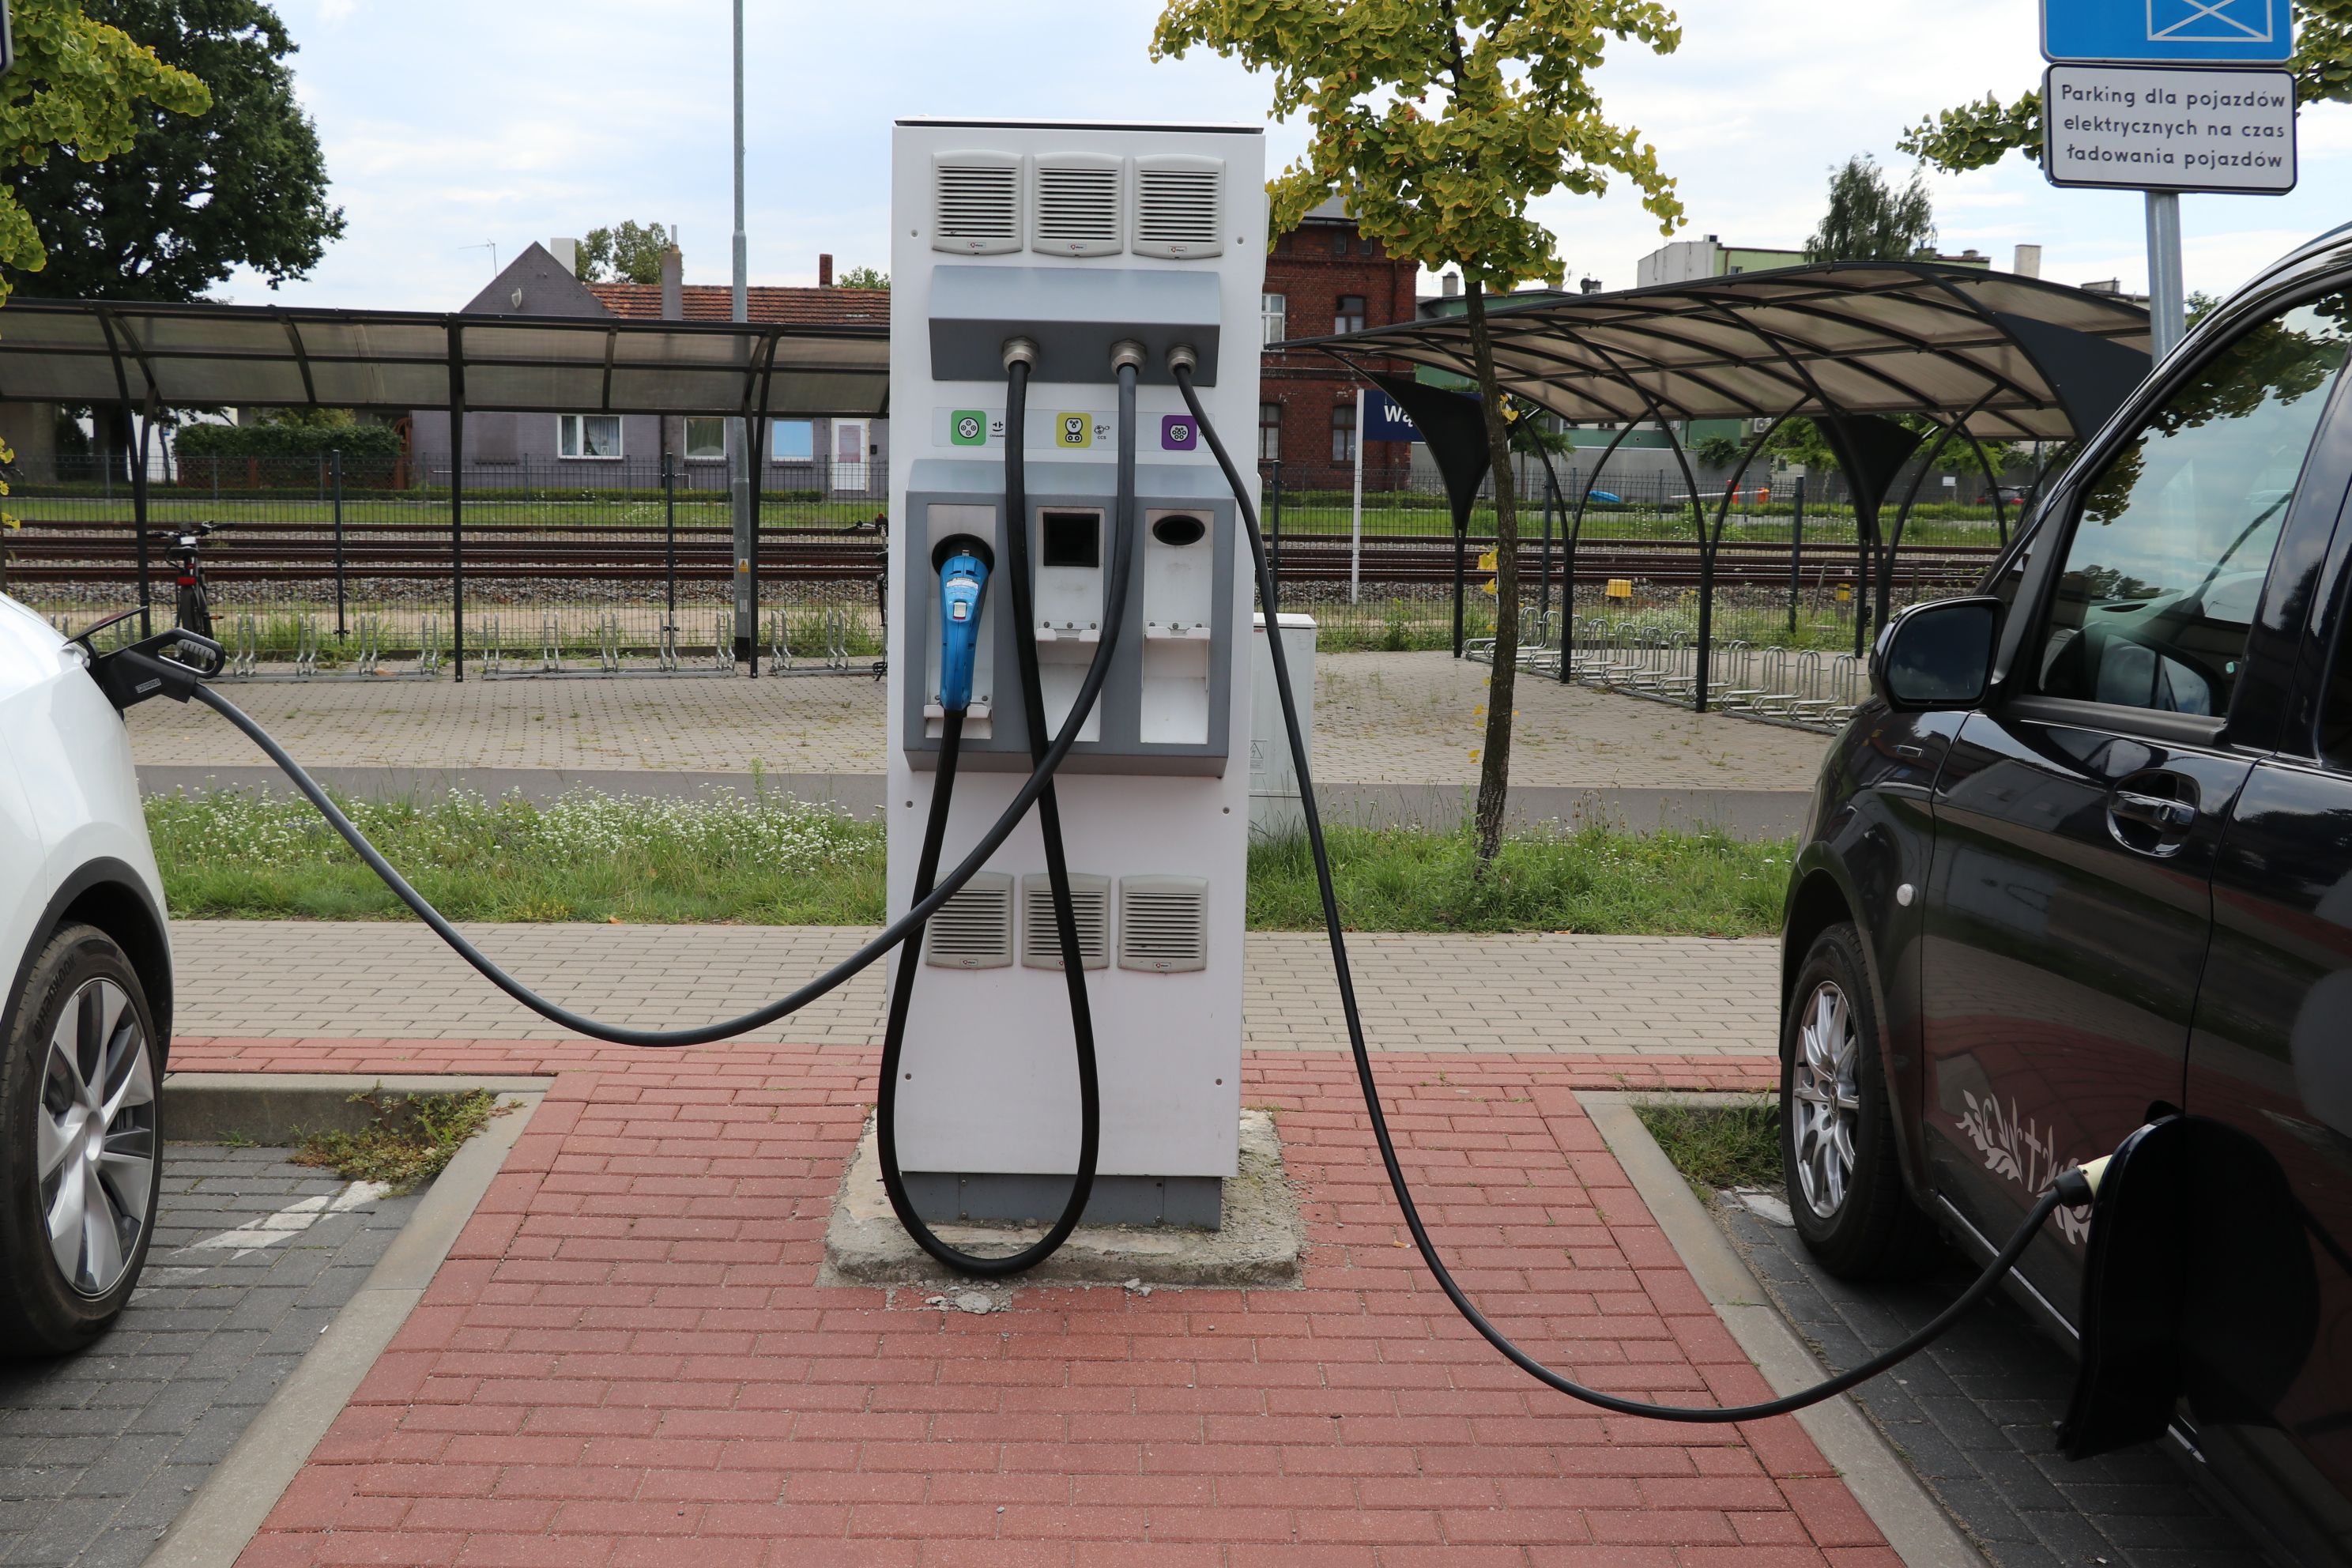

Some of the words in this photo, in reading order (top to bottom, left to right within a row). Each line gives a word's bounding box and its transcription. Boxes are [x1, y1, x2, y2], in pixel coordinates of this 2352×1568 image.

[2061, 84, 2135, 107] Parking
[2145, 88, 2177, 104] dla
[2187, 89, 2286, 110] pojazdów
[2064, 115, 2197, 139] elektrycznych
[2207, 124, 2232, 136] na
[2241, 125, 2285, 138] czas
[2067, 143, 2174, 164] ładowania
[2184, 149, 2282, 170] pojazdów
